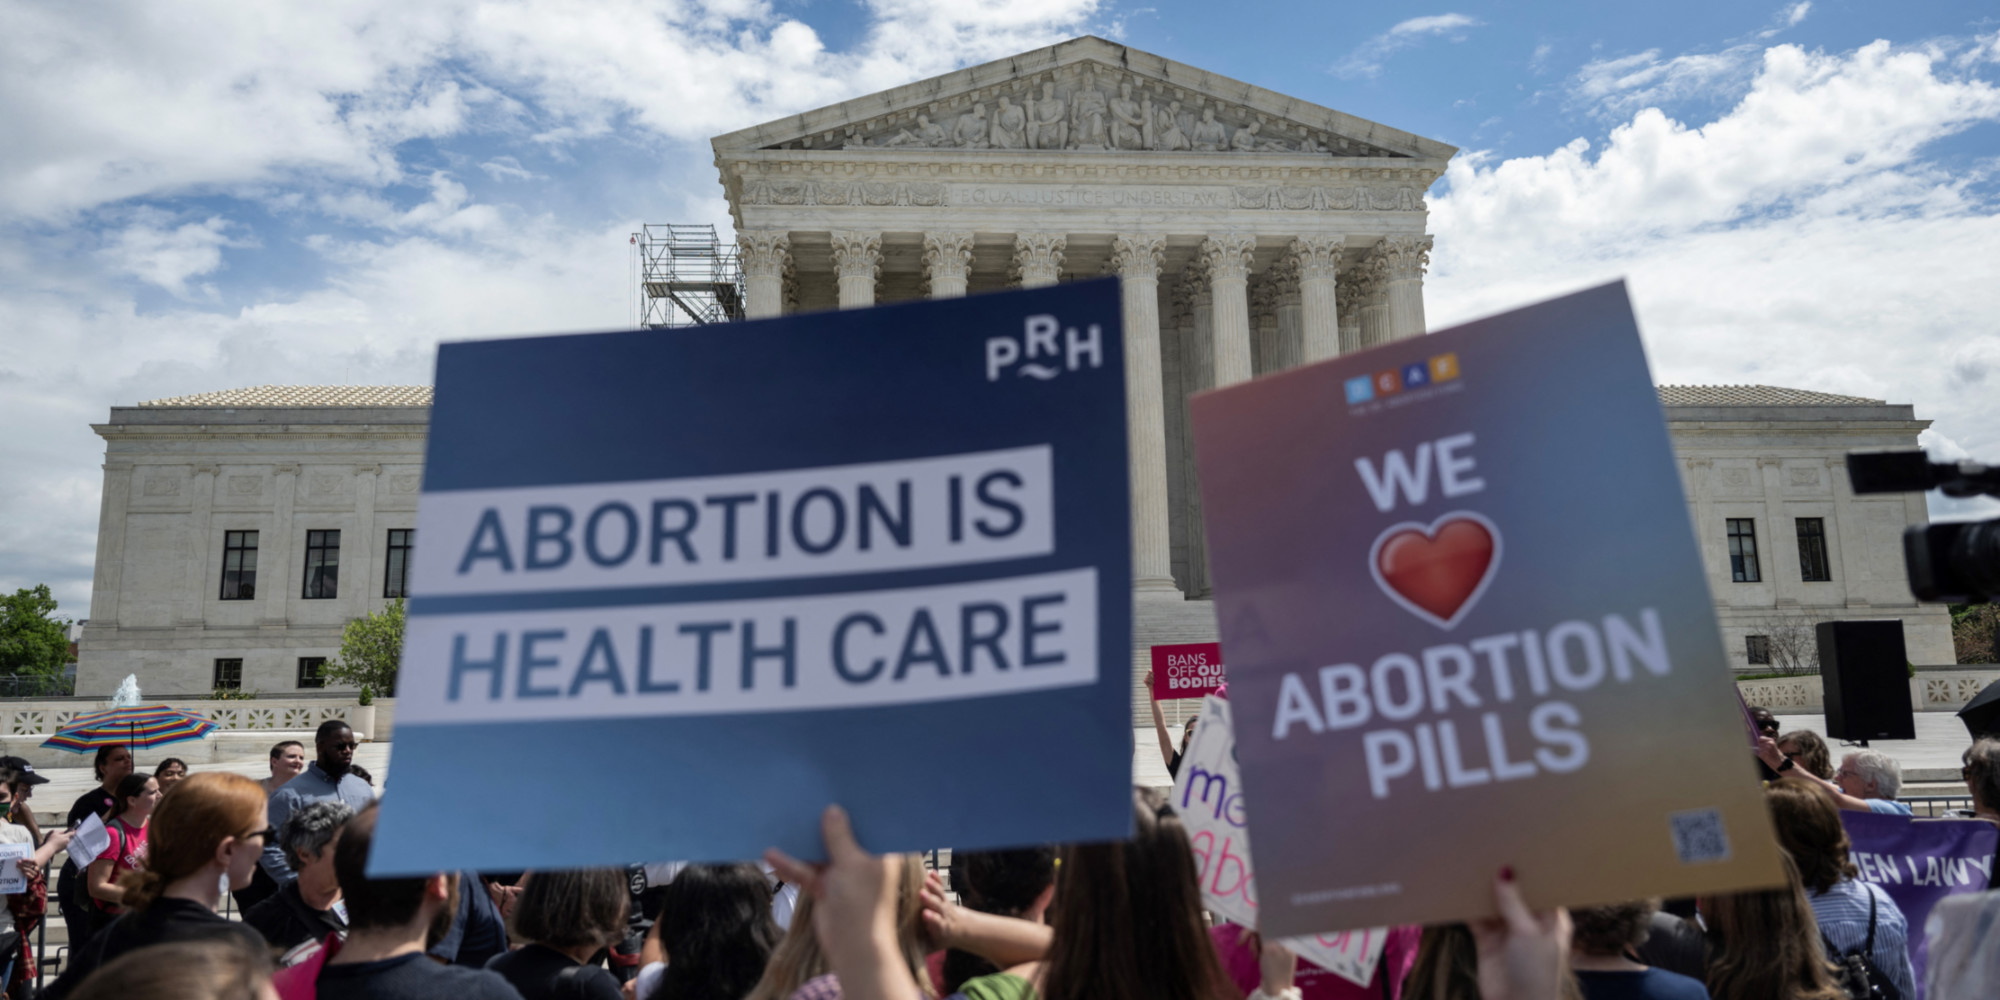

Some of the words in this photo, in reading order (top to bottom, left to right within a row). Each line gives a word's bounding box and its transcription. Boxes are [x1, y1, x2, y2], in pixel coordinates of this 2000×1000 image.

[961, 188, 1026, 206] EQUAL
[1033, 189, 1102, 205] JUSTICE
[1112, 190, 1177, 205] UNDER
[1182, 190, 1218, 205] LAW
[986, 314, 1102, 381] PRH
[1353, 431, 1485, 513] WE
[456, 480, 914, 575] ABORTION
[948, 469, 1026, 544] IS
[446, 617, 797, 702] HEALTH
[830, 593, 1068, 685] CARE
[1167, 653, 1207, 666] BANS
[1167, 665, 1196, 678] OFF
[1169, 676, 1226, 690] BODIES
[1272, 607, 1672, 740] ABORTION
[1363, 701, 1591, 798] PILLS
